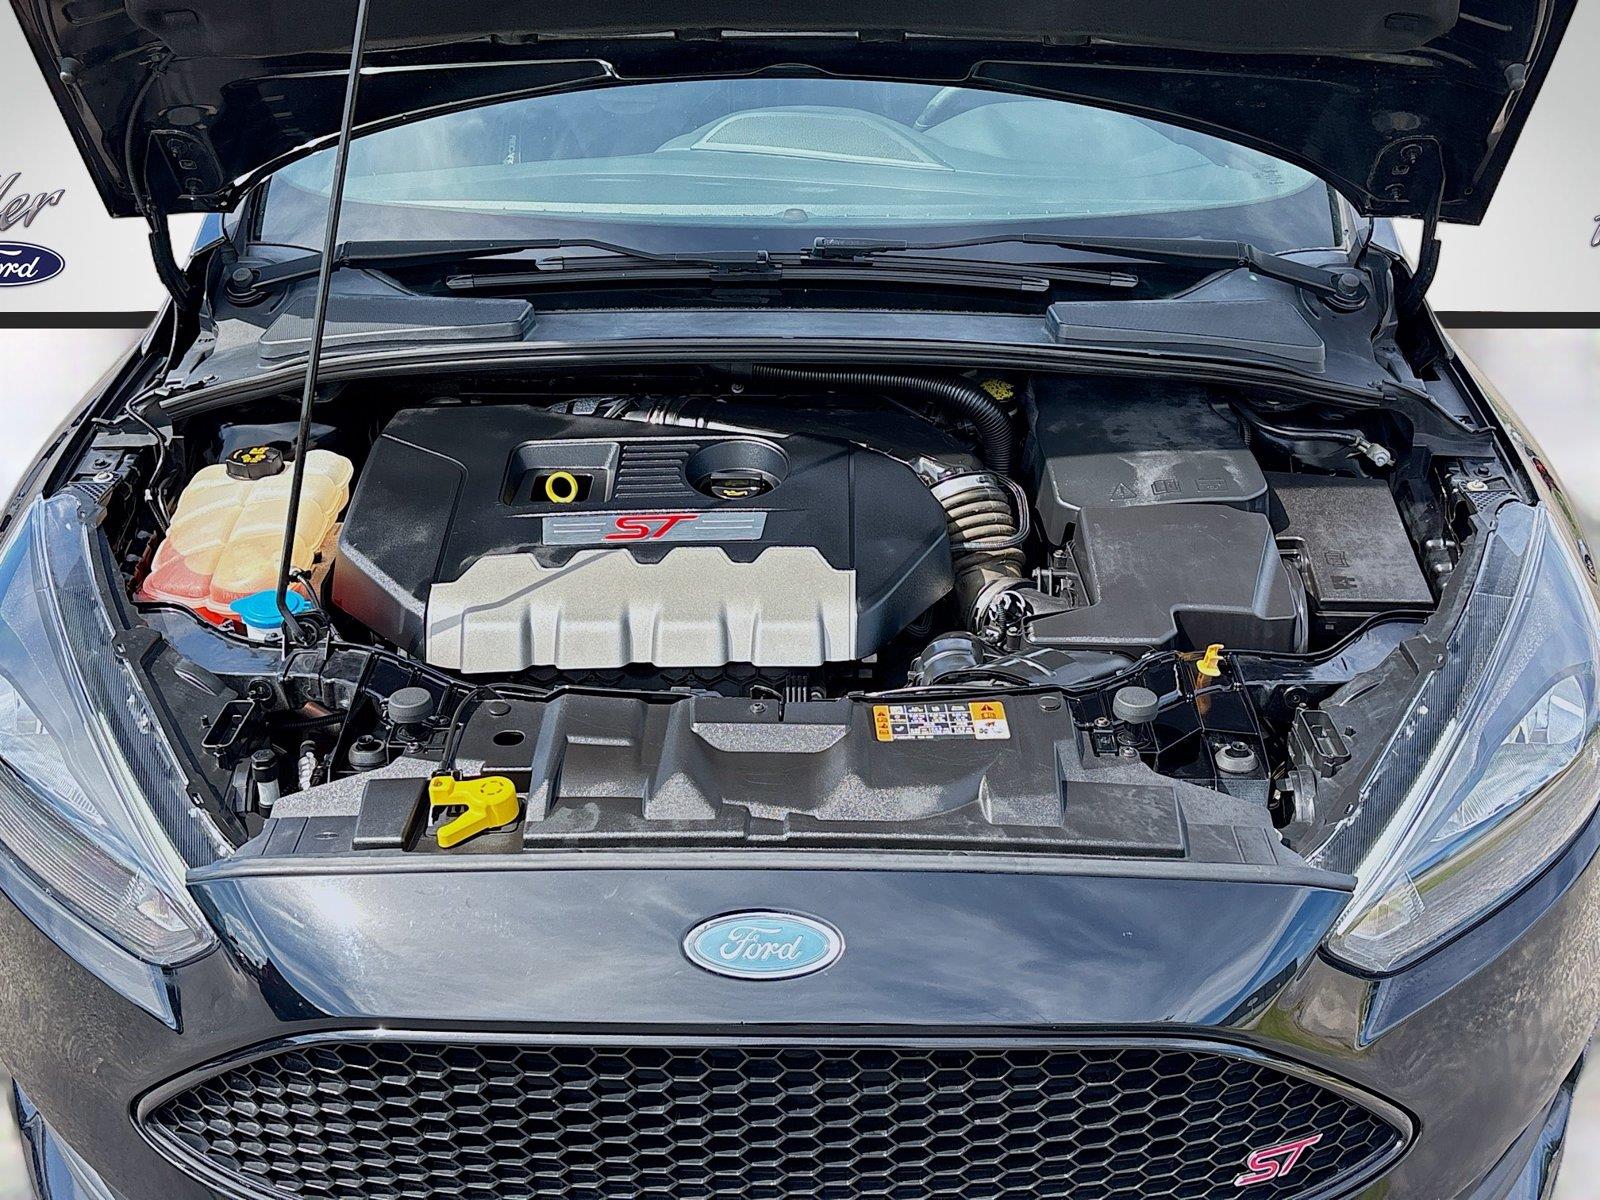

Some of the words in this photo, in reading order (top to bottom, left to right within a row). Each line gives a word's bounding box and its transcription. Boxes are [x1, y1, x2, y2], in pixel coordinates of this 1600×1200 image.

[0, 249, 41, 278] rd
[603, 512, 699, 541] ST
[719, 925, 804, 961] Ford
[1233, 1133, 1324, 1187] ST
